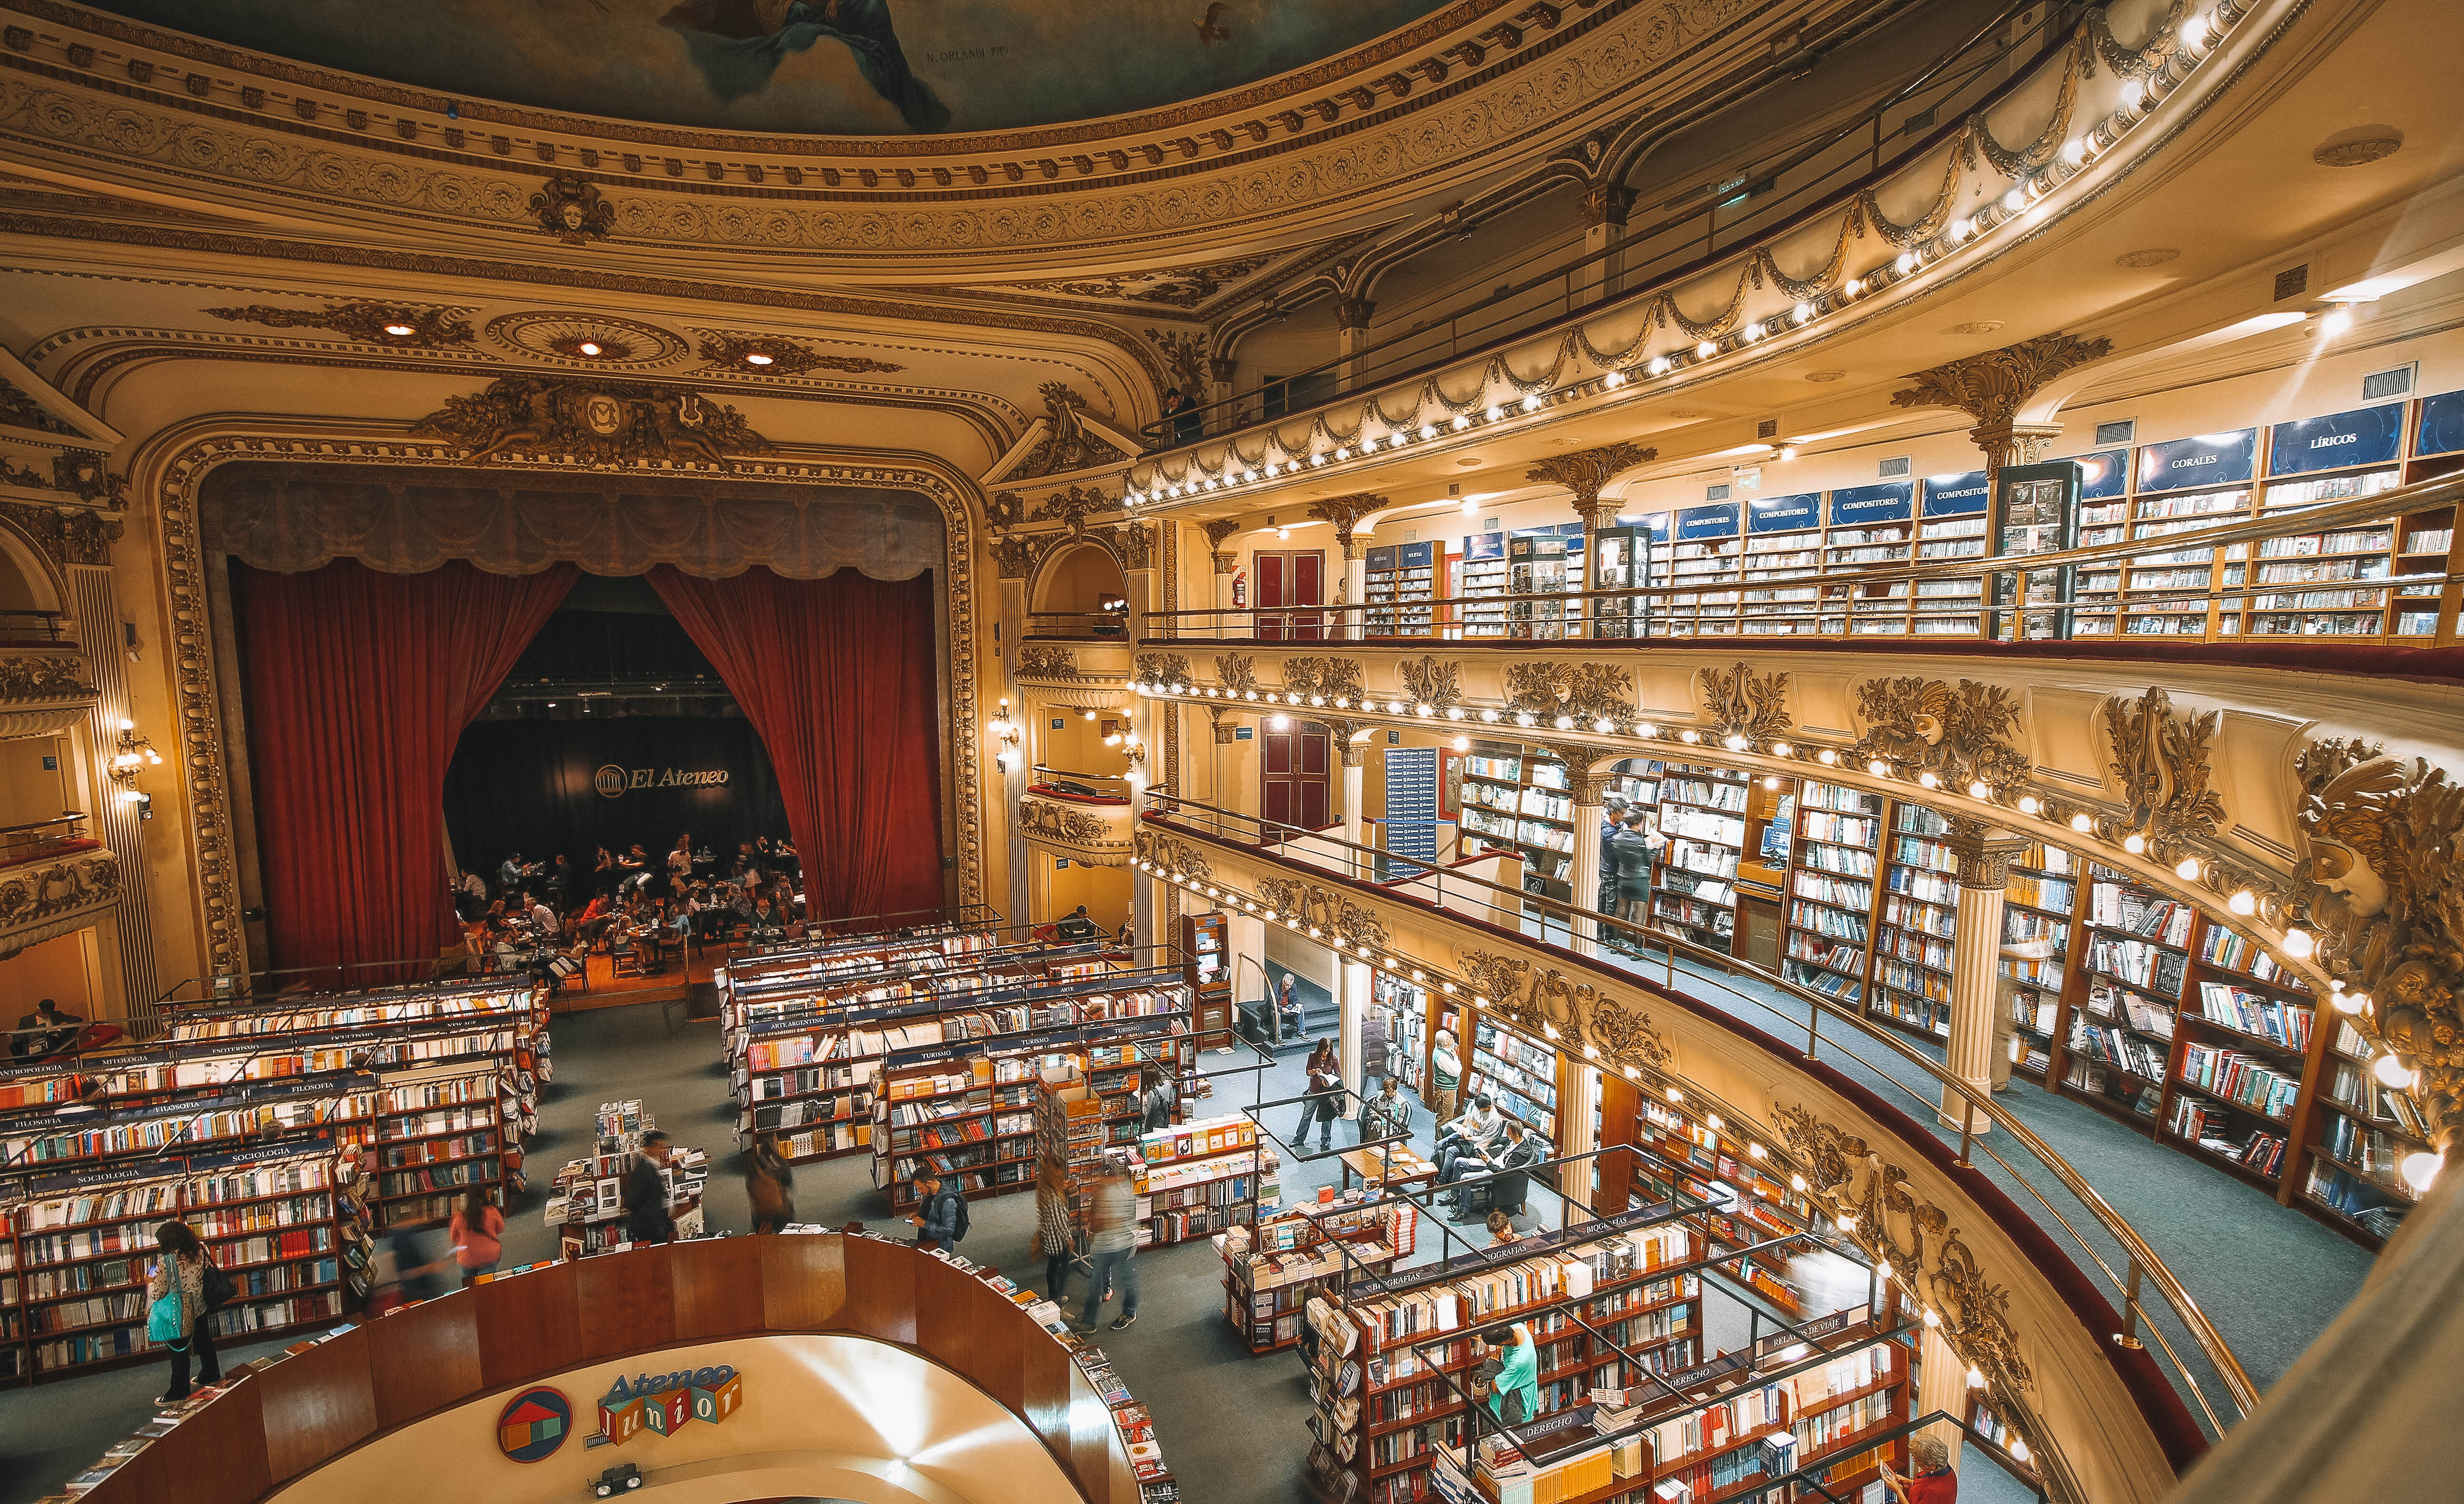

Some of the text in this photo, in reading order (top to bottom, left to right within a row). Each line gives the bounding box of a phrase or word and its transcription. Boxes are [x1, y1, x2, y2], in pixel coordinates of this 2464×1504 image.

[940, 48, 985, 62] ORLANDI
[2310, 433, 2357, 450] LÍRICOS
[2171, 454, 2217, 469] CORALES
[1937, 486, 1988, 500] COMPOSITOR
[1842, 497, 1898, 511] COMPOSITORES
[1759, 508, 1809, 520] COMPOSITORES
[1686, 516, 1730, 527] COMPOSITORES
[629, 768, 729, 789] El Ateneo
[886, 1007, 902, 1015] ARTE
[770, 1017, 825, 1030] ARTE ARGENTINO
[1114, 1025, 1141, 1035] TURISMO
[1021, 1037, 1049, 1045] TURISMO
[212, 1044, 260, 1054] ESOTERISMO
[921, 1049, 952, 1059] TURISMO
[1586, 1217, 1628, 1234] BIOGRFÍAS
[1809, 1325, 1820, 1334] DE
[1820, 1318, 1840, 1331] VIAJE
[606, 1364, 735, 1405] Ateneo
[1670, 1368, 1710, 1387] DERECHO
[601, 1383, 739, 1437] Junior
[1526, 1416, 1573, 1437] DERECHO
